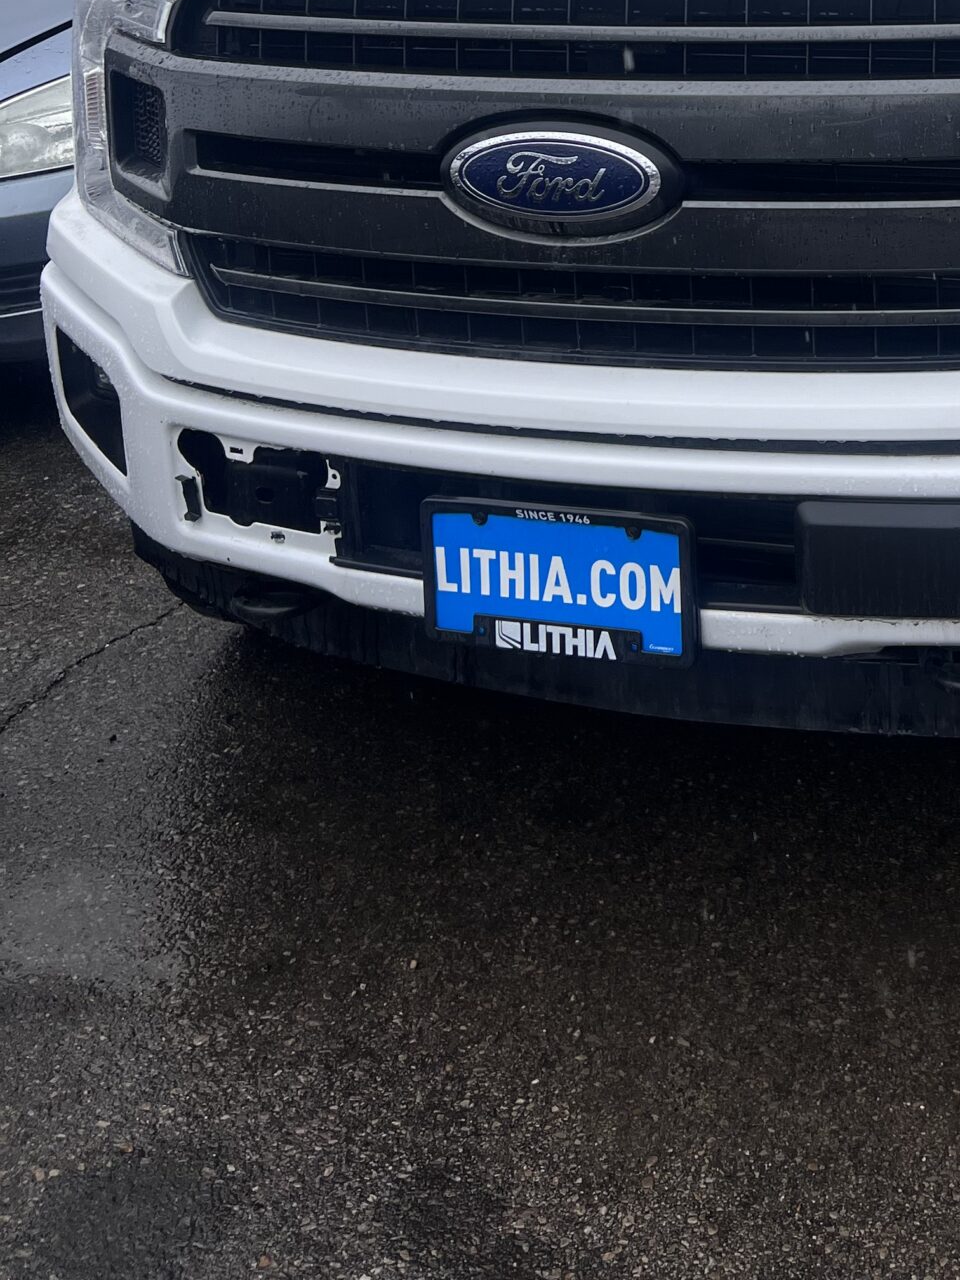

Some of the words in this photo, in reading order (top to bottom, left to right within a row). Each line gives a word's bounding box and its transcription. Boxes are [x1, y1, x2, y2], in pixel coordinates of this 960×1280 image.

[496, 151, 606, 202] Ford
[515, 509, 556, 522] SINCE
[559, 513, 591, 524] 1946
[435, 546, 681, 613] LITHIA.COM
[522, 622, 616, 660] LITHIA
